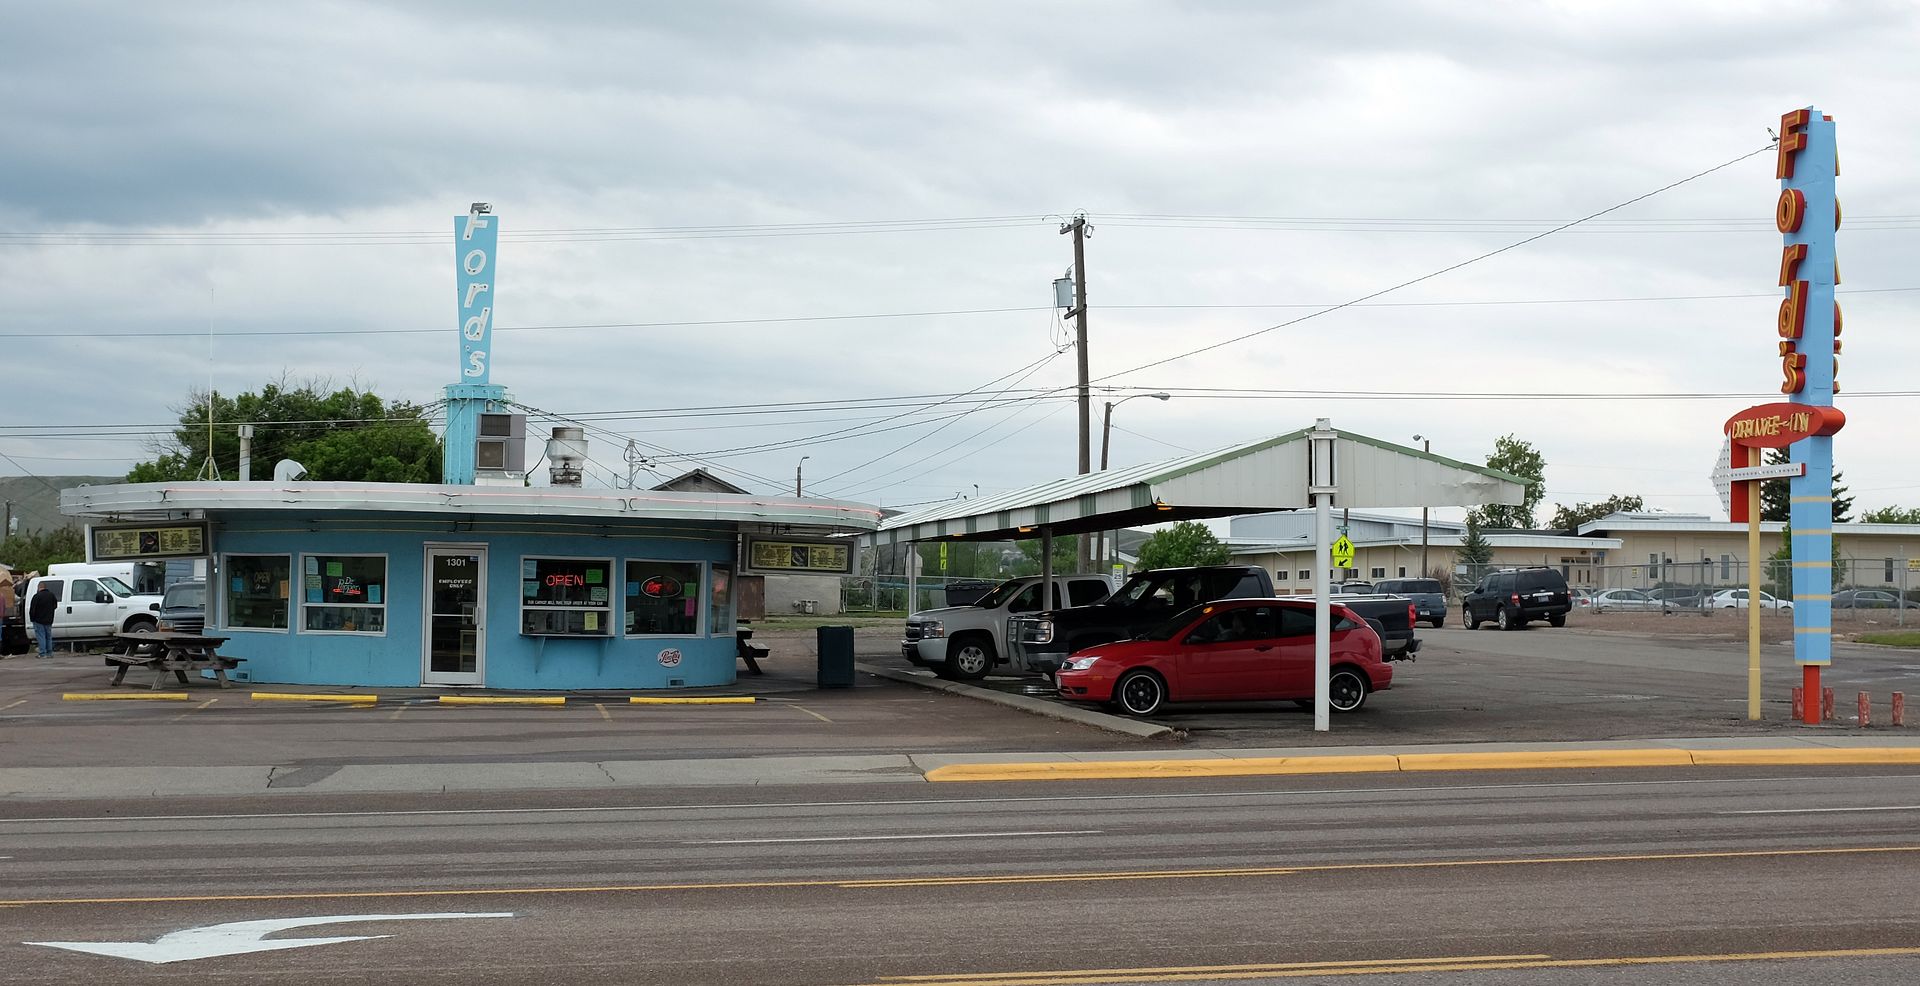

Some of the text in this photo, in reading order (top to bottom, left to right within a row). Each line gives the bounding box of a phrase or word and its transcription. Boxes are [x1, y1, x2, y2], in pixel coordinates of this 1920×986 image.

[1776, 109, 1809, 394] Ford's
[463, 203, 493, 378] Ford's
[446, 558, 466, 567] 1301
[254, 571, 272, 584] OPEN
[545, 574, 584, 587] OPEN
